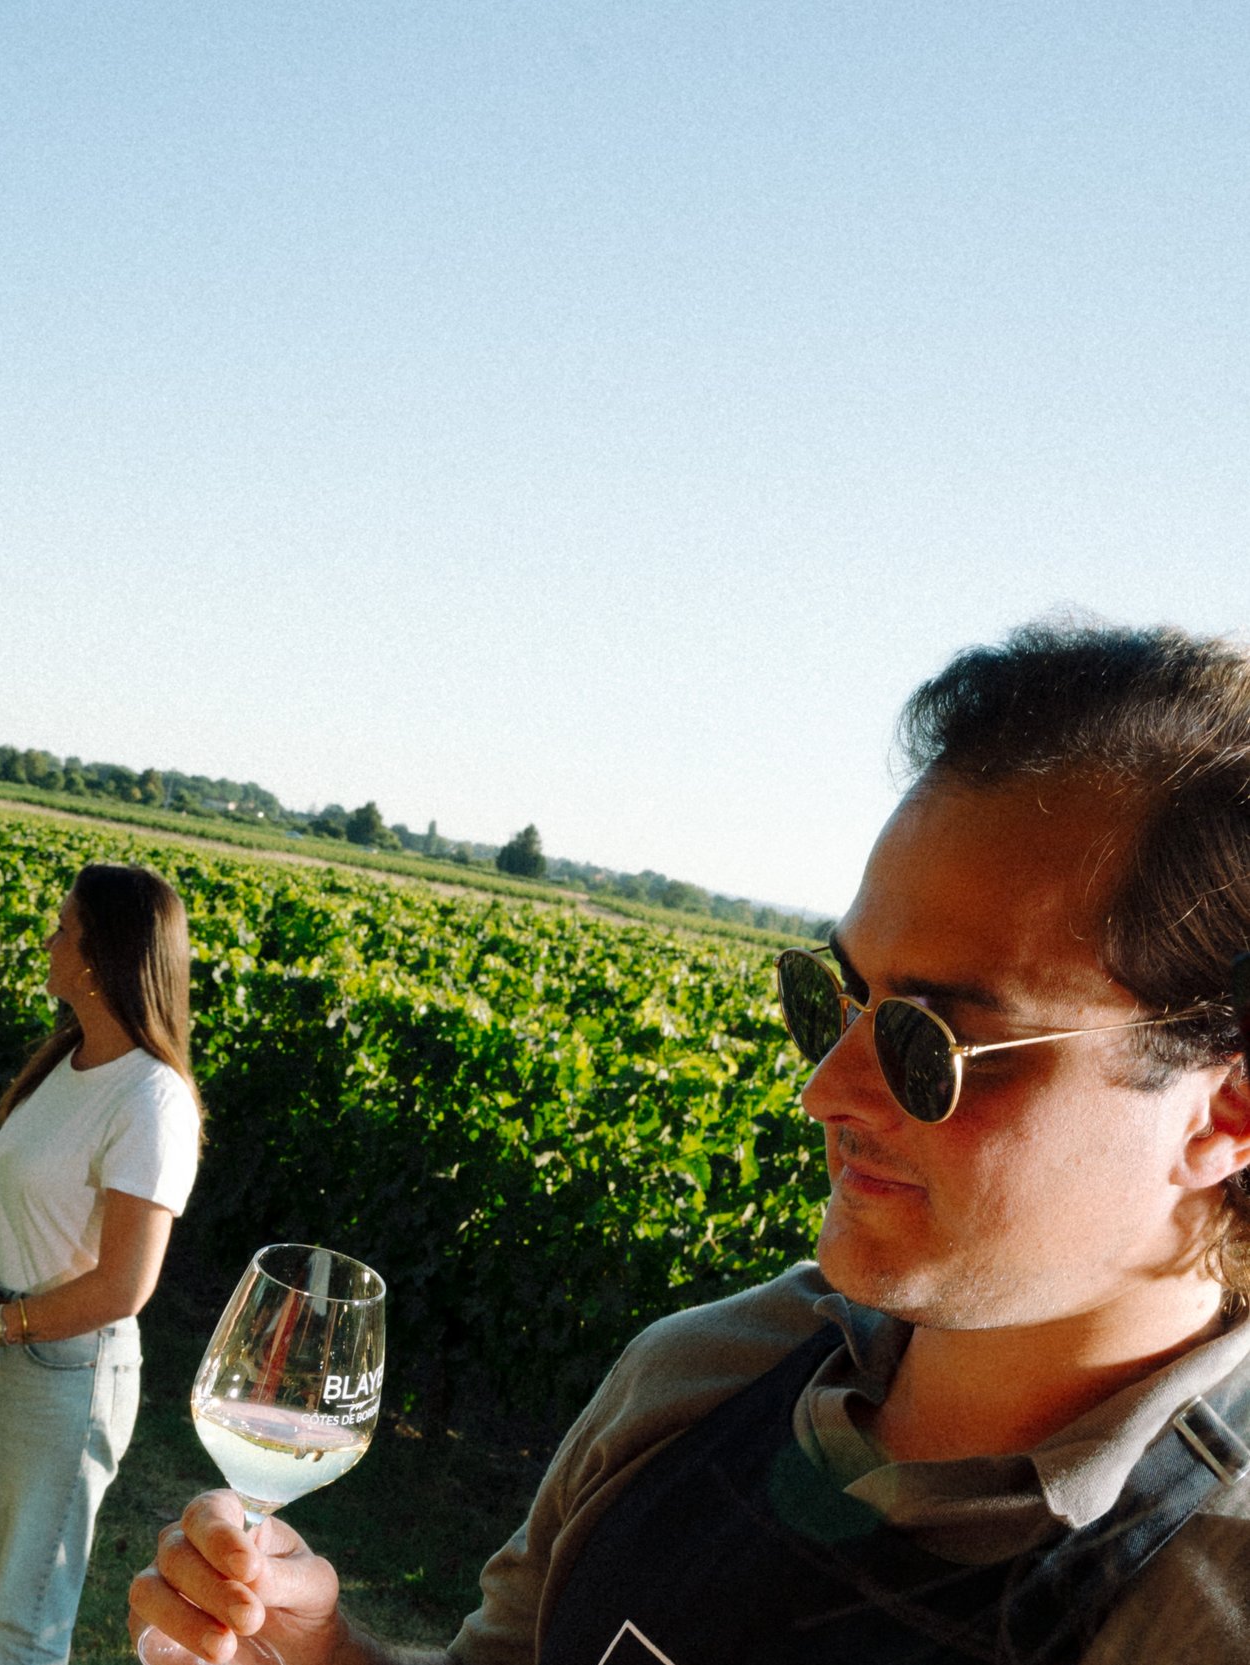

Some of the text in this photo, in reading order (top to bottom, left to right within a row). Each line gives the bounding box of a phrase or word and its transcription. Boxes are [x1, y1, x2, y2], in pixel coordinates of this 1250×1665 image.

[323, 1362, 384, 1400] BLAYE
[301, 1413, 340, 1426] CÔTES
[341, 1413, 356, 1426] DE
